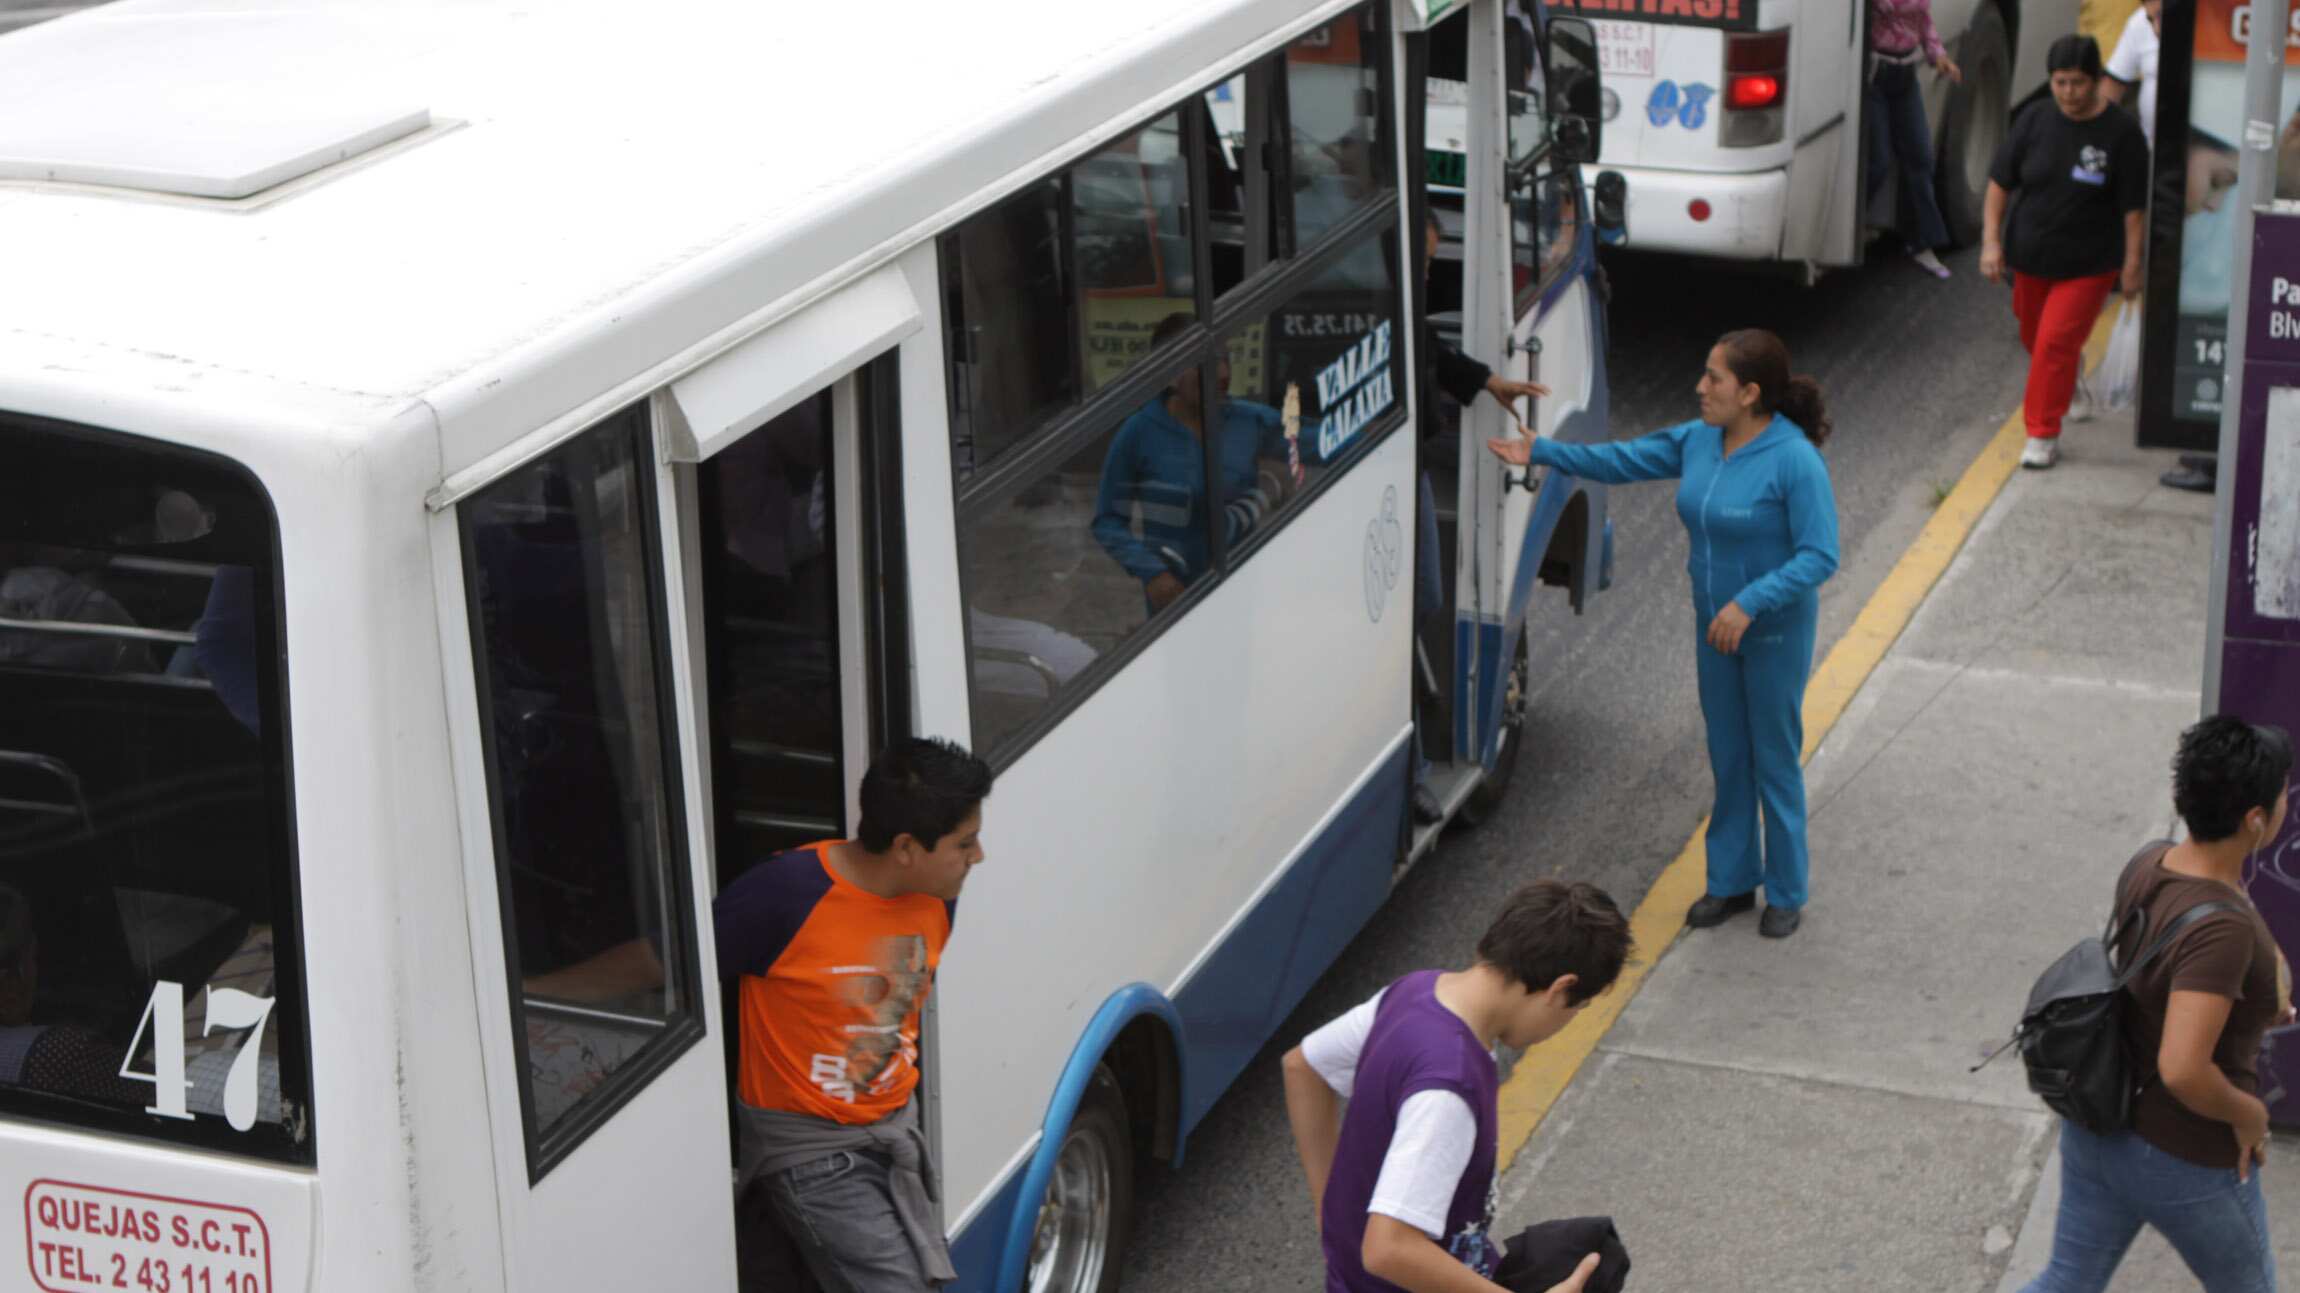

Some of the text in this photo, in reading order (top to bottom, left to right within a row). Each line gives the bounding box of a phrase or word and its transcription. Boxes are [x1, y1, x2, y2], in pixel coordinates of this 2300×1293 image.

[1317, 319, 1391, 413] VALLE
[1318, 366, 1394, 459] GALAXIA
[119, 980, 276, 1132] 47
[37, 1195, 257, 1258] QUEJAS S.C.T.
[38, 1242, 102, 1284] TEL.
[110, 1253, 128, 1289] 2
[137, 1257, 171, 1293] 43
[182, 1263, 211, 1293] 11
